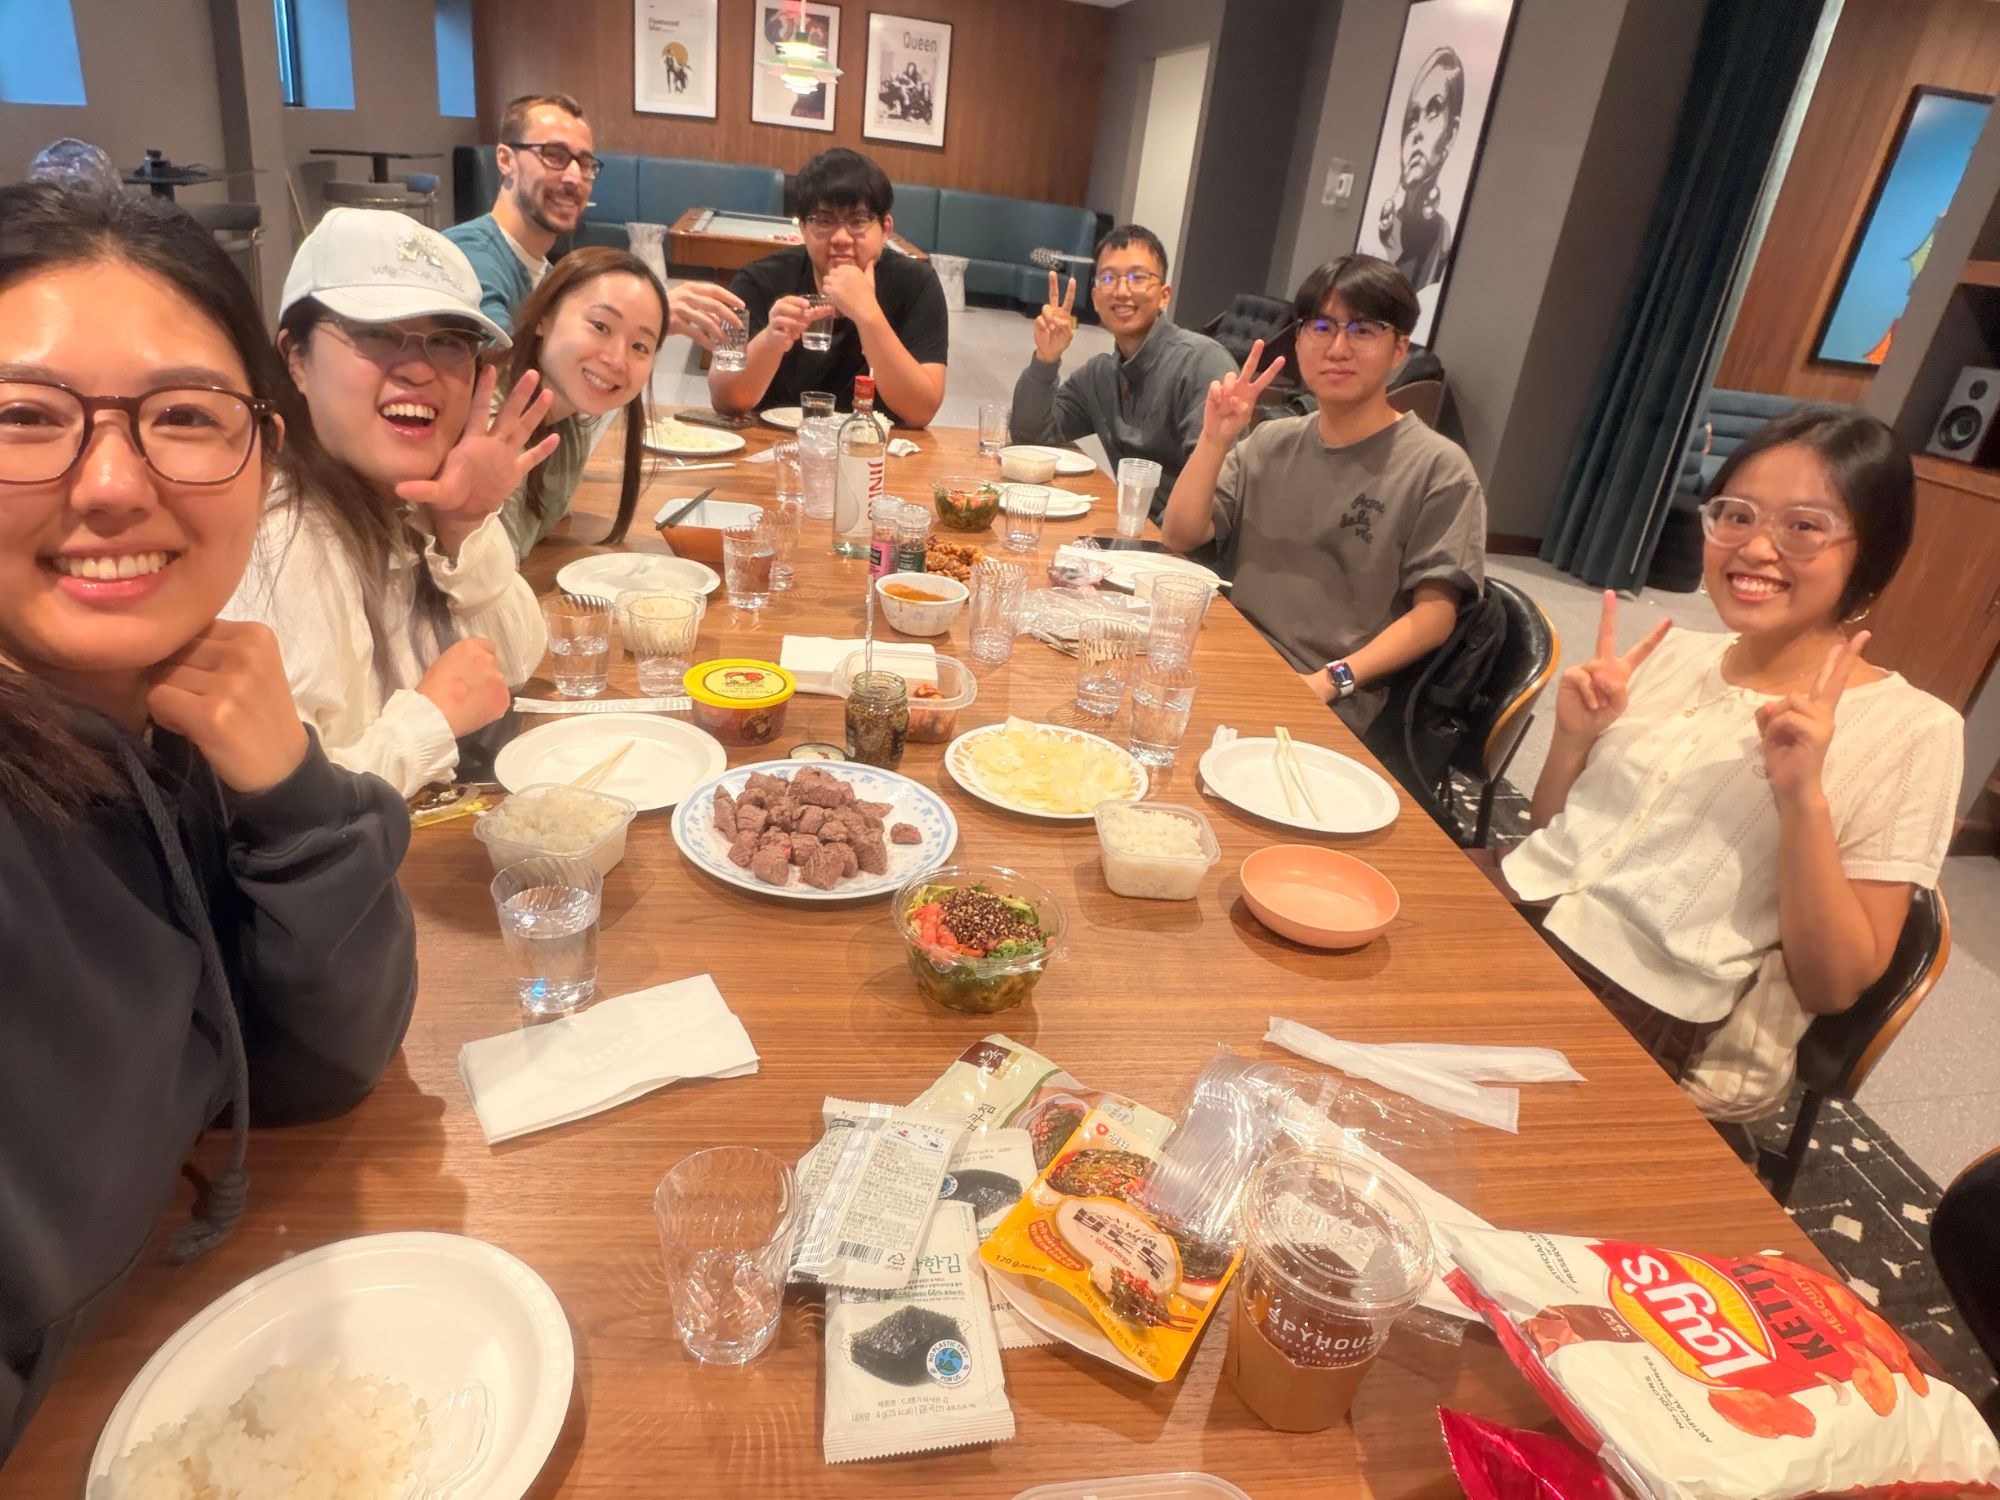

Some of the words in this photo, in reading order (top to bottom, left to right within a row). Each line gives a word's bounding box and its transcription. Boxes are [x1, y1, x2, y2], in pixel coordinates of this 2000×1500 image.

[903, 31, 937, 53] Queen
[867, 461, 883, 520] JIN
[995, 1254, 1011, 1265] 120
[1534, 1243, 1566, 1284] ARTIFICIAL
[1621, 1254, 1772, 1378] Lay's
[1791, 1275, 1847, 1335] MESQUIT
[933, 1340, 957, 1353] PLASTIC
[1643, 1355, 1674, 1398] SOURCES
[1645, 1375, 1674, 1413] COLORS
[1673, 1399, 1714, 1443] ARTIFICIAL
